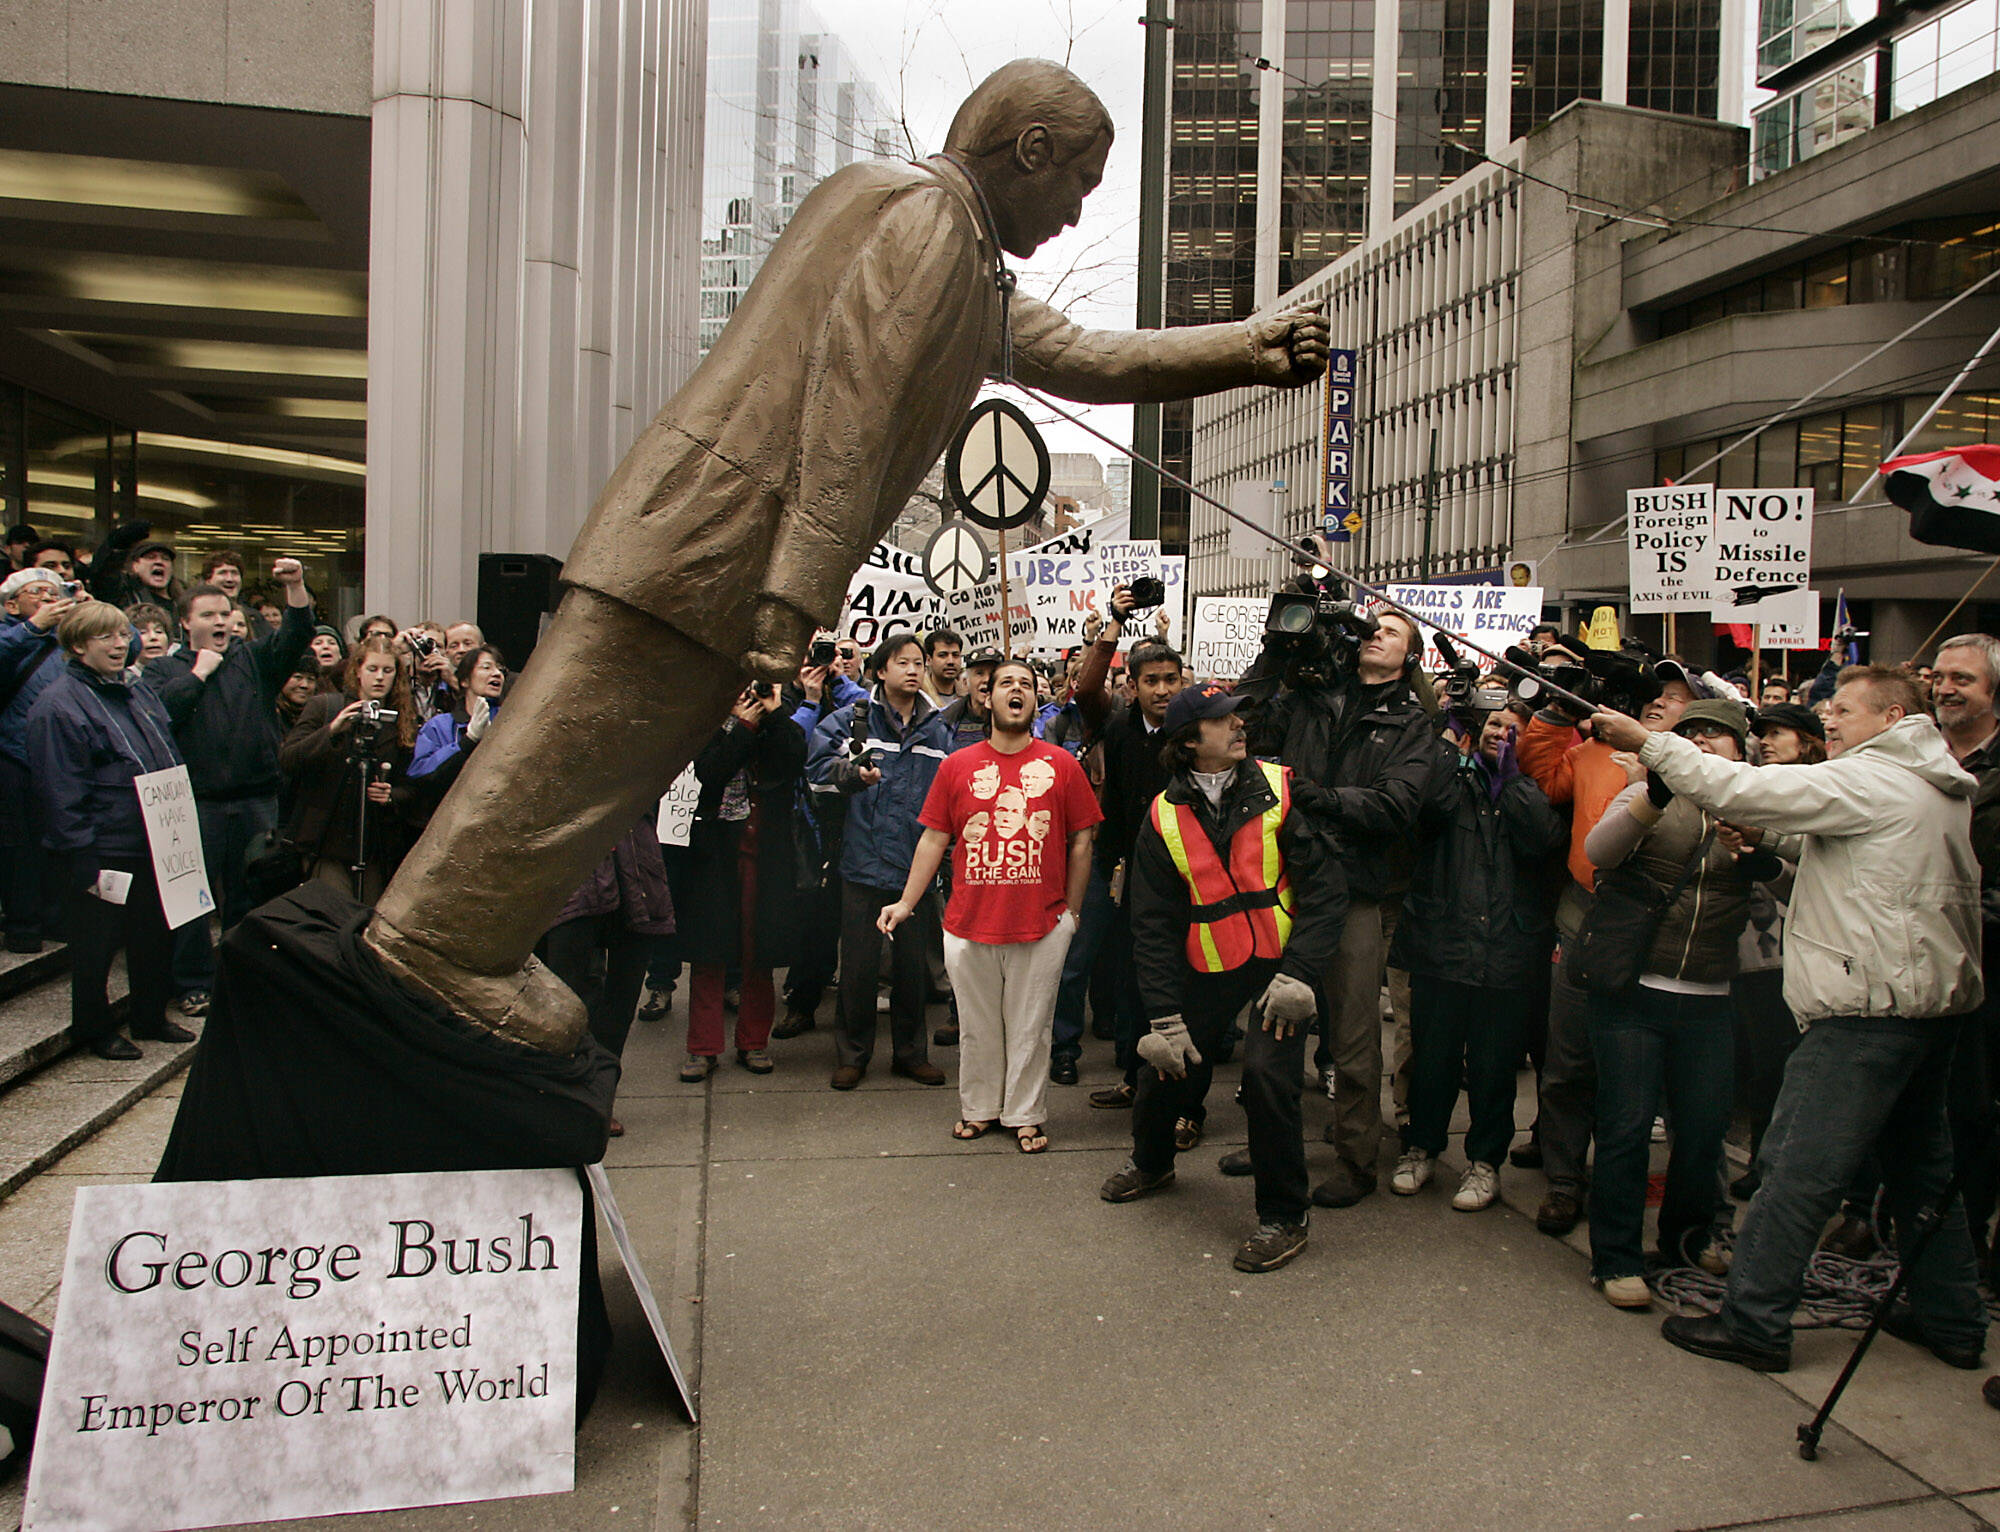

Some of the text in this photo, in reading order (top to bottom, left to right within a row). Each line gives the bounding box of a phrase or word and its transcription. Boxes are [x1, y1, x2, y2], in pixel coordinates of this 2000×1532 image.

[1328, 388, 1350, 506] PARK
[1634, 492, 1707, 513] BUSH
[1726, 494, 1804, 522] NO!
[1634, 513, 1708, 530] Foreign
[1753, 527, 1768, 537] to
[1635, 531, 1708, 552] Policy
[1100, 544, 1157, 560] OTTAWA
[1718, 544, 1807, 562] Missile
[1102, 560, 1150, 575] NEEDS
[1656, 551, 1687, 573] IS
[1015, 558, 1072, 586] UBC
[1714, 566, 1808, 584] Defence
[1661, 576, 1684, 587] the
[949, 590, 970, 606] GO
[974, 598, 995, 610] AND
[1037, 595, 1057, 606] SAY
[1394, 588, 1463, 609] IRAQIS
[1472, 590, 1506, 609] ARE
[1633, 590, 1713, 602] AXIS of EVIL
[953, 603, 1032, 631] TAKE MATIN
[1203, 603, 1268, 623] GEORGE
[1047, 617, 1077, 635] WAR
[1474, 613, 1537, 633] BEINGS
[966, 628, 1000, 646] WITH
[1197, 640, 1255, 659] PUTTING
[1197, 660, 1211, 673] IN
[159, 806, 187, 828] HAVE
[172, 829, 181, 847] A
[965, 839, 1044, 868] BUSH
[974, 867, 1003, 879] THE
[105, 1212, 559, 1300] George Bush
[176, 1314, 473, 1367] Self Appointed
[77, 1363, 549, 1437] Emperor Of The World
